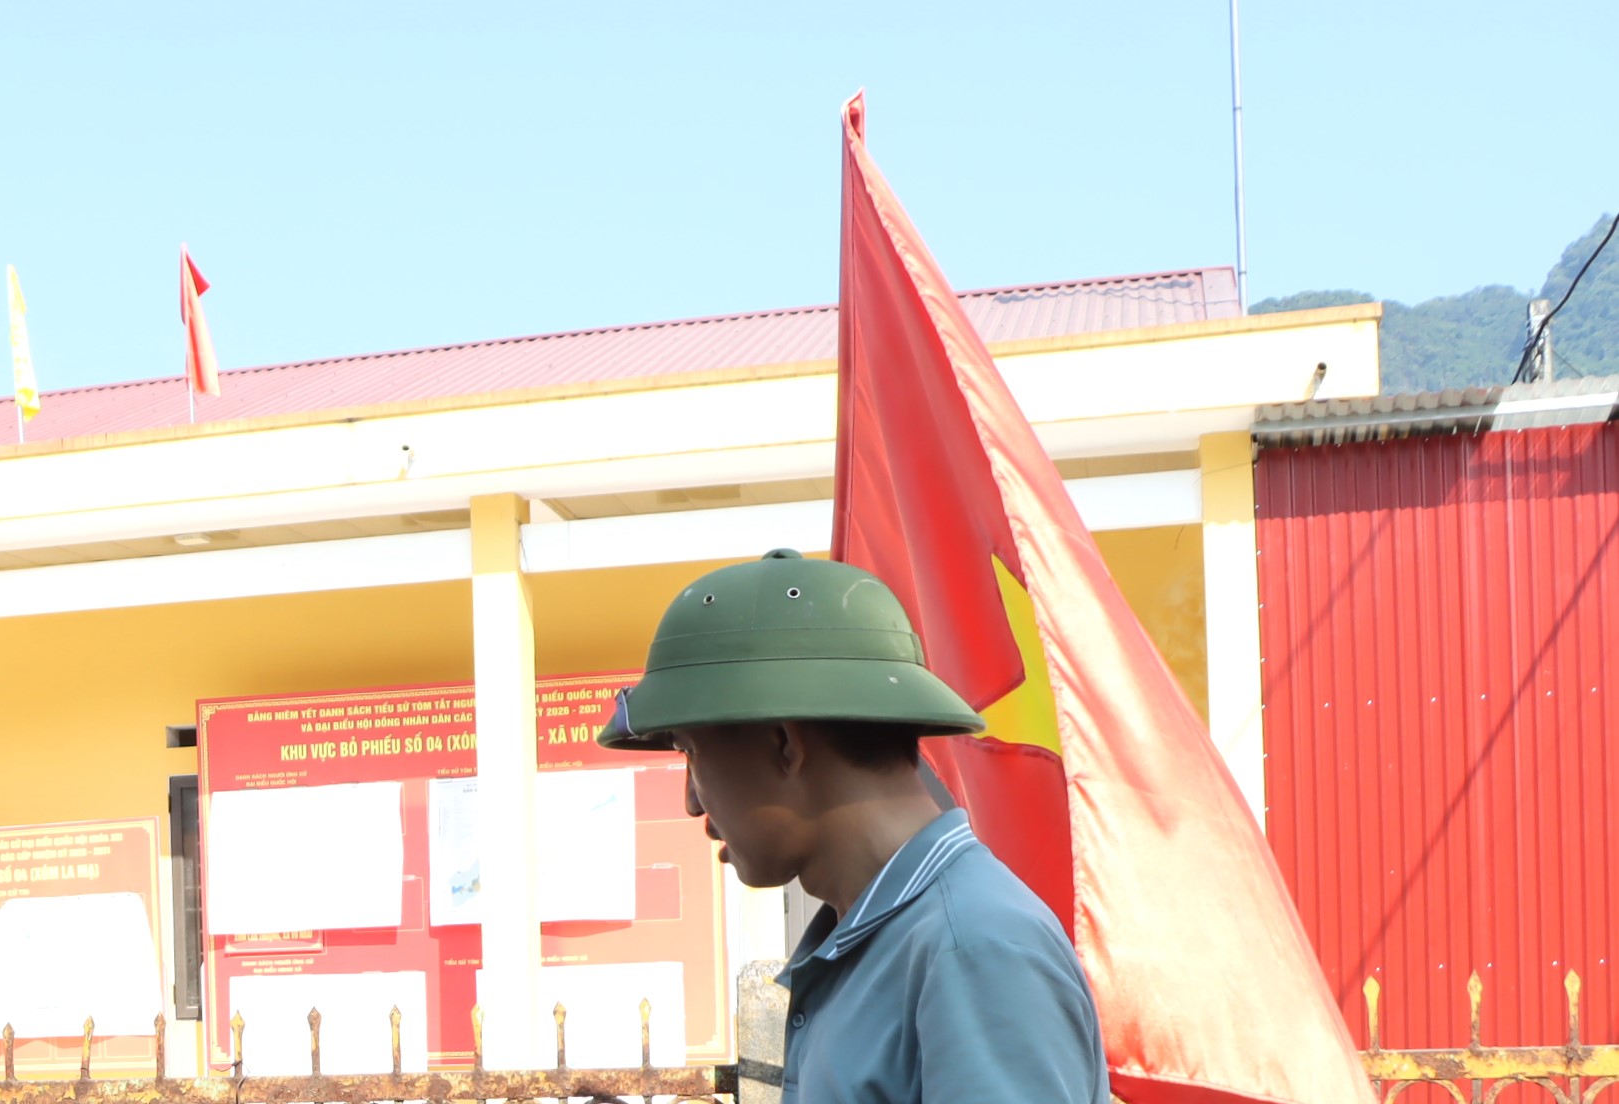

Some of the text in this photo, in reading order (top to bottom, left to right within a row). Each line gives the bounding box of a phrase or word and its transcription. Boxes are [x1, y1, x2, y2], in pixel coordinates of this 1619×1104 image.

[275, 709, 299, 720] NIÊM
[301, 707, 318, 719] YẾT
[320, 708, 344, 718] DANH
[347, 705, 372, 716] SÁCH
[374, 701, 394, 714] TIỂU
[412, 700, 432, 712] TÓM
[453, 698, 475, 709] NGƯ
[542, 690, 564, 702] BIỂU
[566, 688, 592, 701] QUỐC
[596, 687, 612, 700] HỘI
[301, 722, 313, 732] VÀ
[315, 722, 331, 734] ĐẠI
[333, 718, 354, 730] BIỂU
[356, 718, 372, 730] HỘI
[374, 716, 400, 728] ĐỒNG
[402, 714, 429, 726] NHÂN
[432, 712, 452, 724] DÂN
[454, 711, 473, 722] CÁC
[546, 706, 570, 716] 2026
[579, 704, 602, 714] 2031
[281, 744, 308, 761] KHU
[311, 741, 336, 762] VỰC
[340, 736, 358, 758] BỎ
[362, 733, 400, 756] PHIẾU
[404, 732, 422, 754] SỐ
[426, 736, 443, 752] 04
[548, 724, 568, 745] XÃ
[570, 722, 589, 743] VÕ
